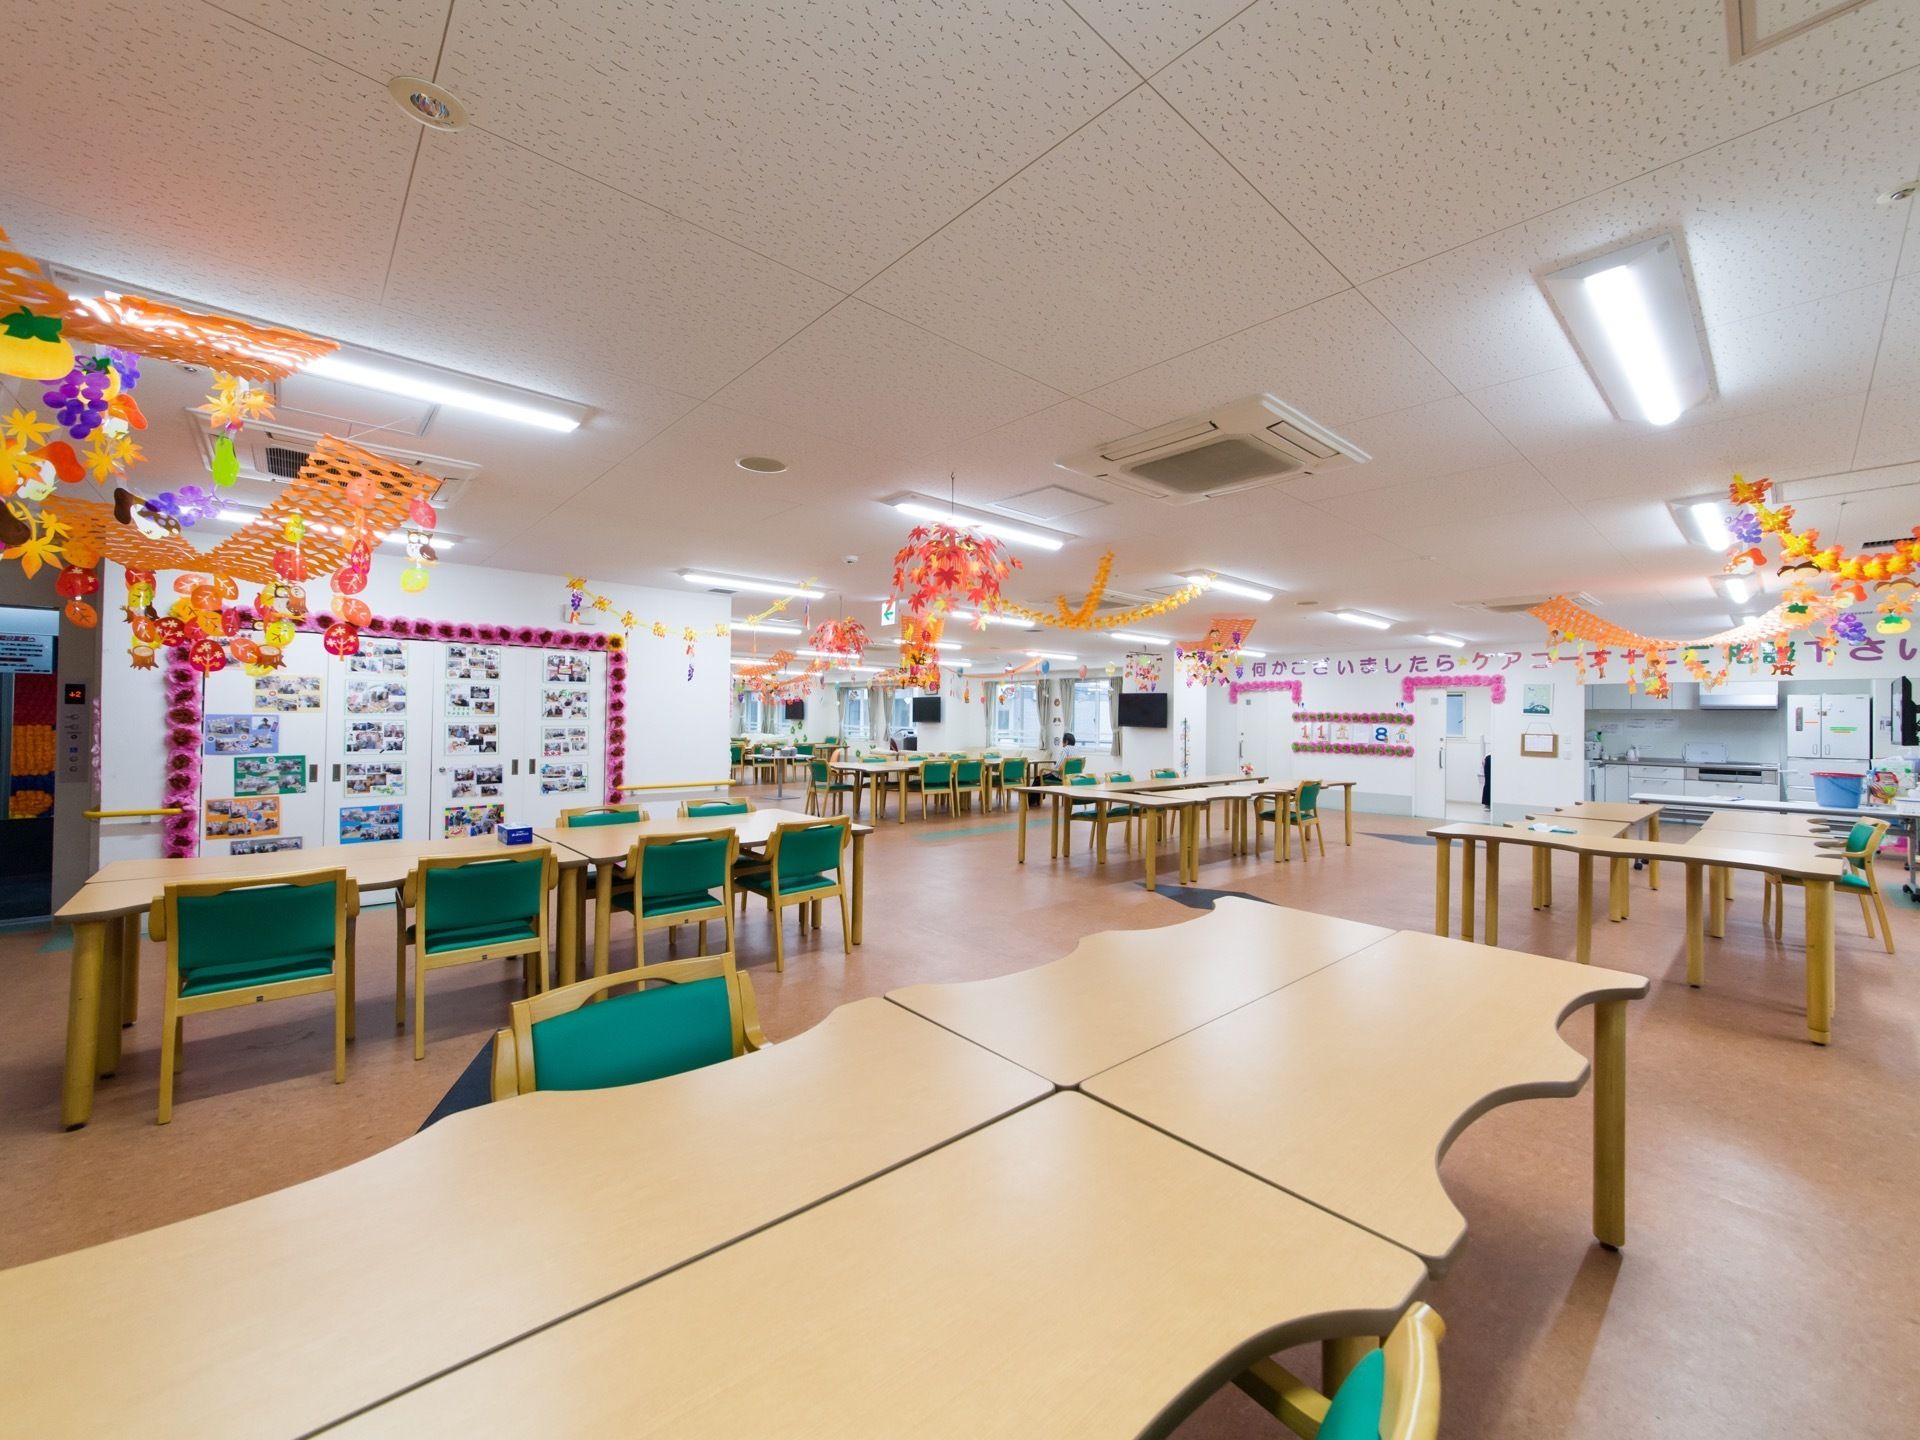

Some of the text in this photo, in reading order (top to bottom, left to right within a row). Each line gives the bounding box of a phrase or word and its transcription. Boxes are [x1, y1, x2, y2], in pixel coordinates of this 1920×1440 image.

[1252, 654, 1455, 677] 何かございましたら
[1375, 727, 1388, 742] 8
